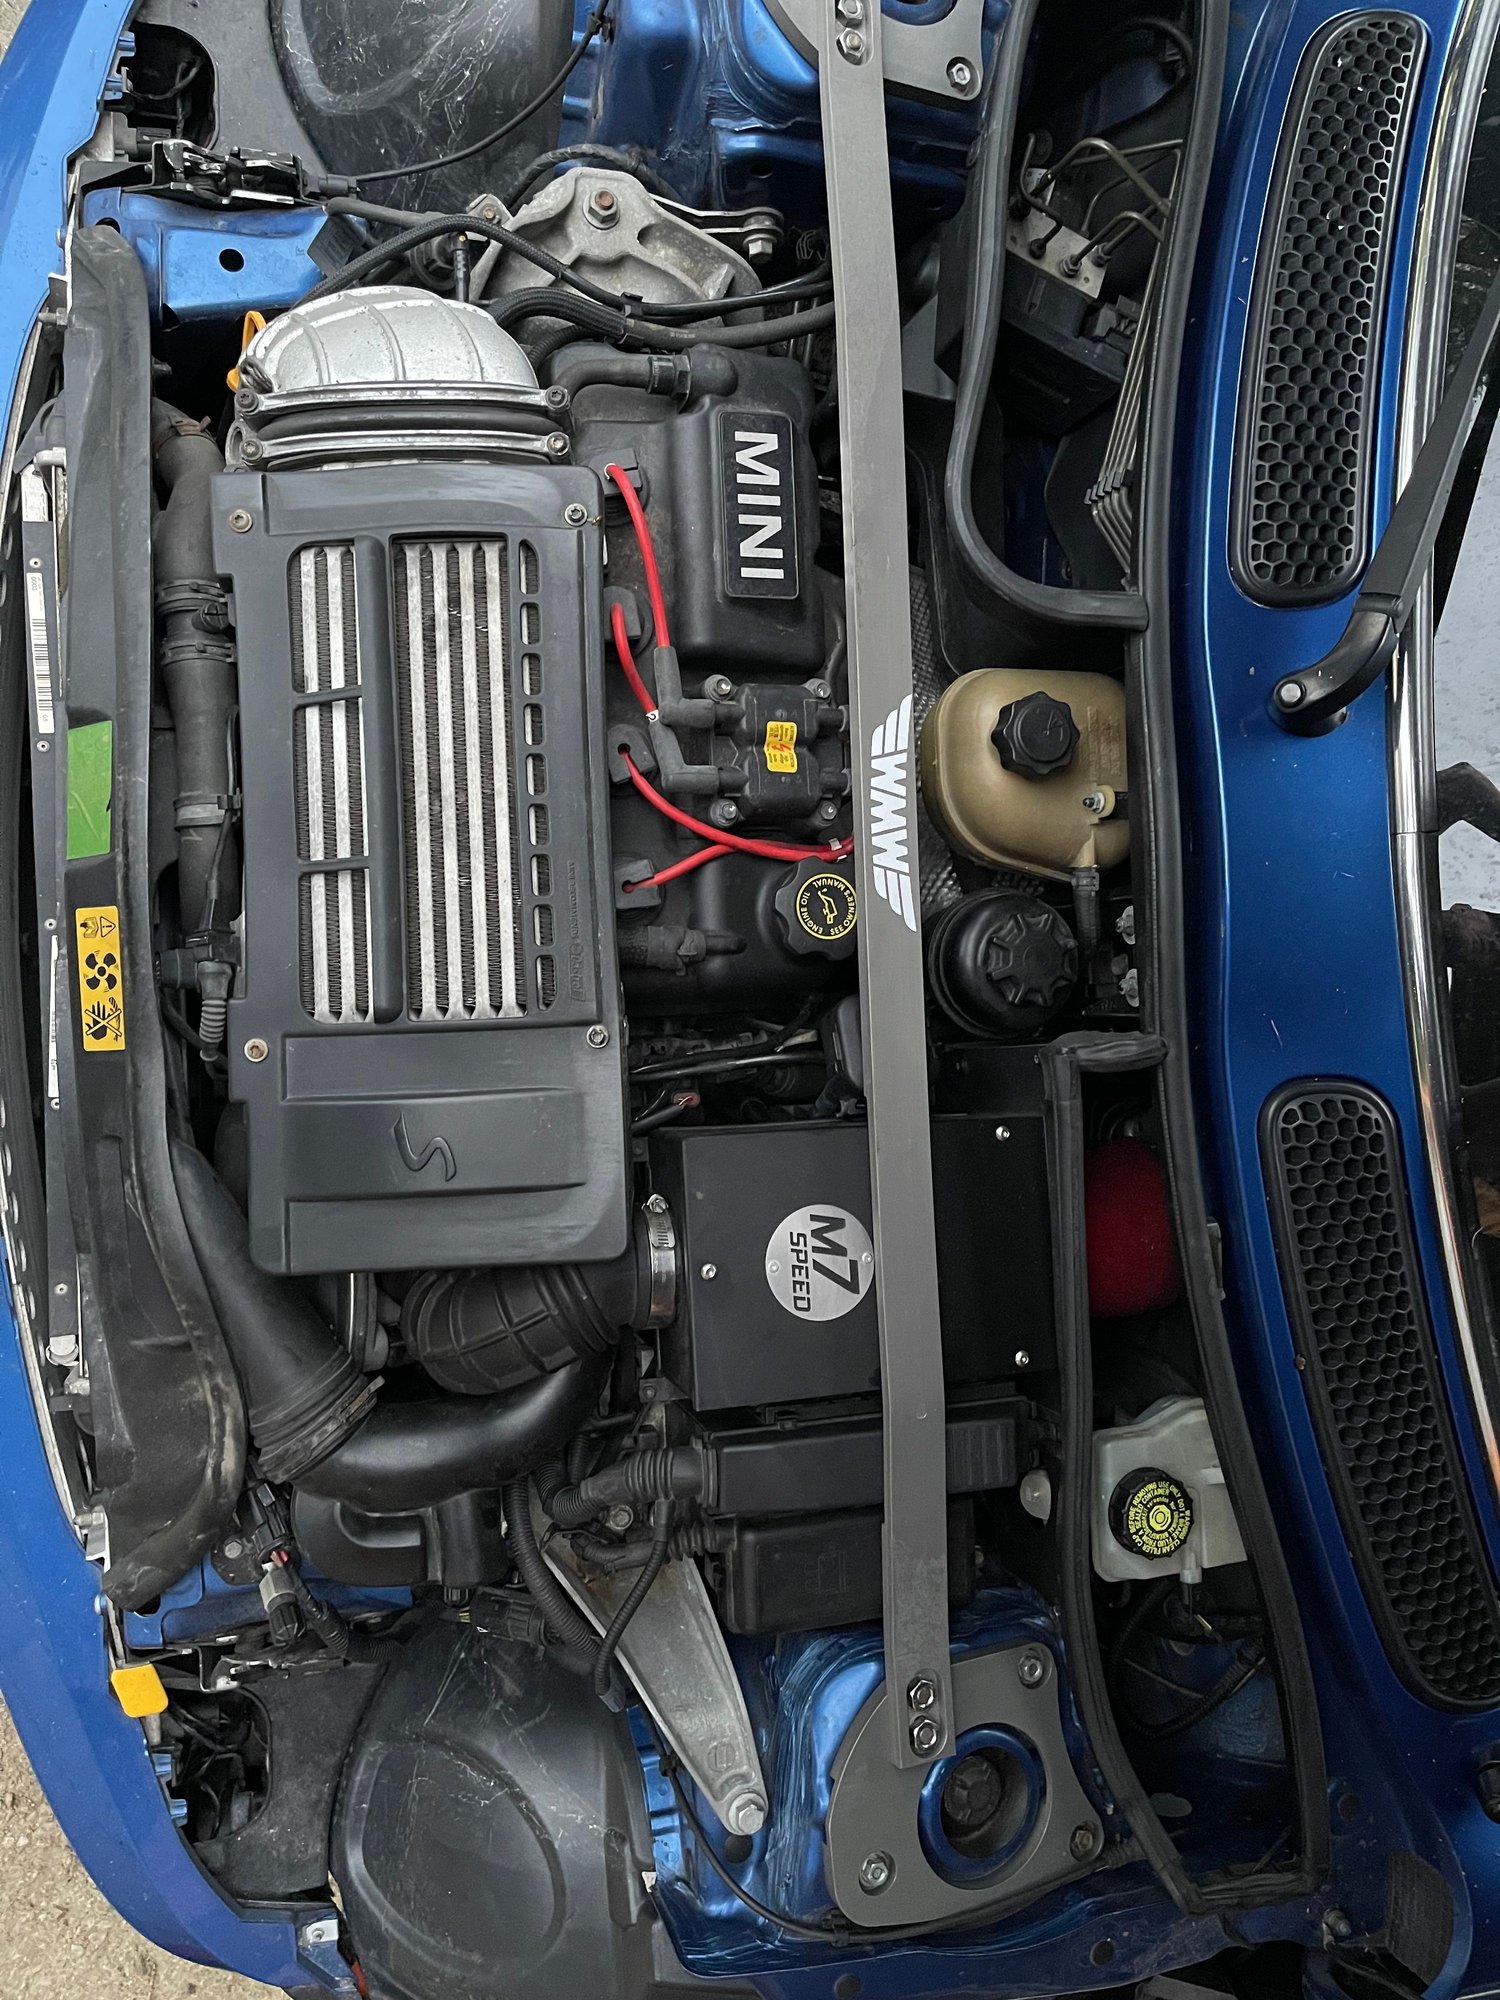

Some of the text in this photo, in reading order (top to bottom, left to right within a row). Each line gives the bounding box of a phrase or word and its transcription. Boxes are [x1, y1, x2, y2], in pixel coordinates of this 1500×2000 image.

[735, 431, 784, 579] MINI
[800, 891, 823, 934] ENGINE OIL
[812, 878, 855, 936] SEE OWNER'S MANUAL
[393, 1113, 457, 1182] S
[810, 1214, 860, 1295] M7
[789, 1232, 811, 1312] SPEED
[1132, 1481, 1157, 1505] REMOVING
[1169, 1484, 1182, 1498] ONLY
[1134, 1503, 1144, 1530] SEALED
[1177, 1498, 1186, 1512] DOT
[1128, 1506, 1137, 1534] BEFORE
[1132, 1534, 1143, 1547] CAP
[1141, 1535, 1157, 1547] FROM
[1142, 1546, 1161, 1555] FILLER
[1162, 1539, 1180, 1554] CLEAN
